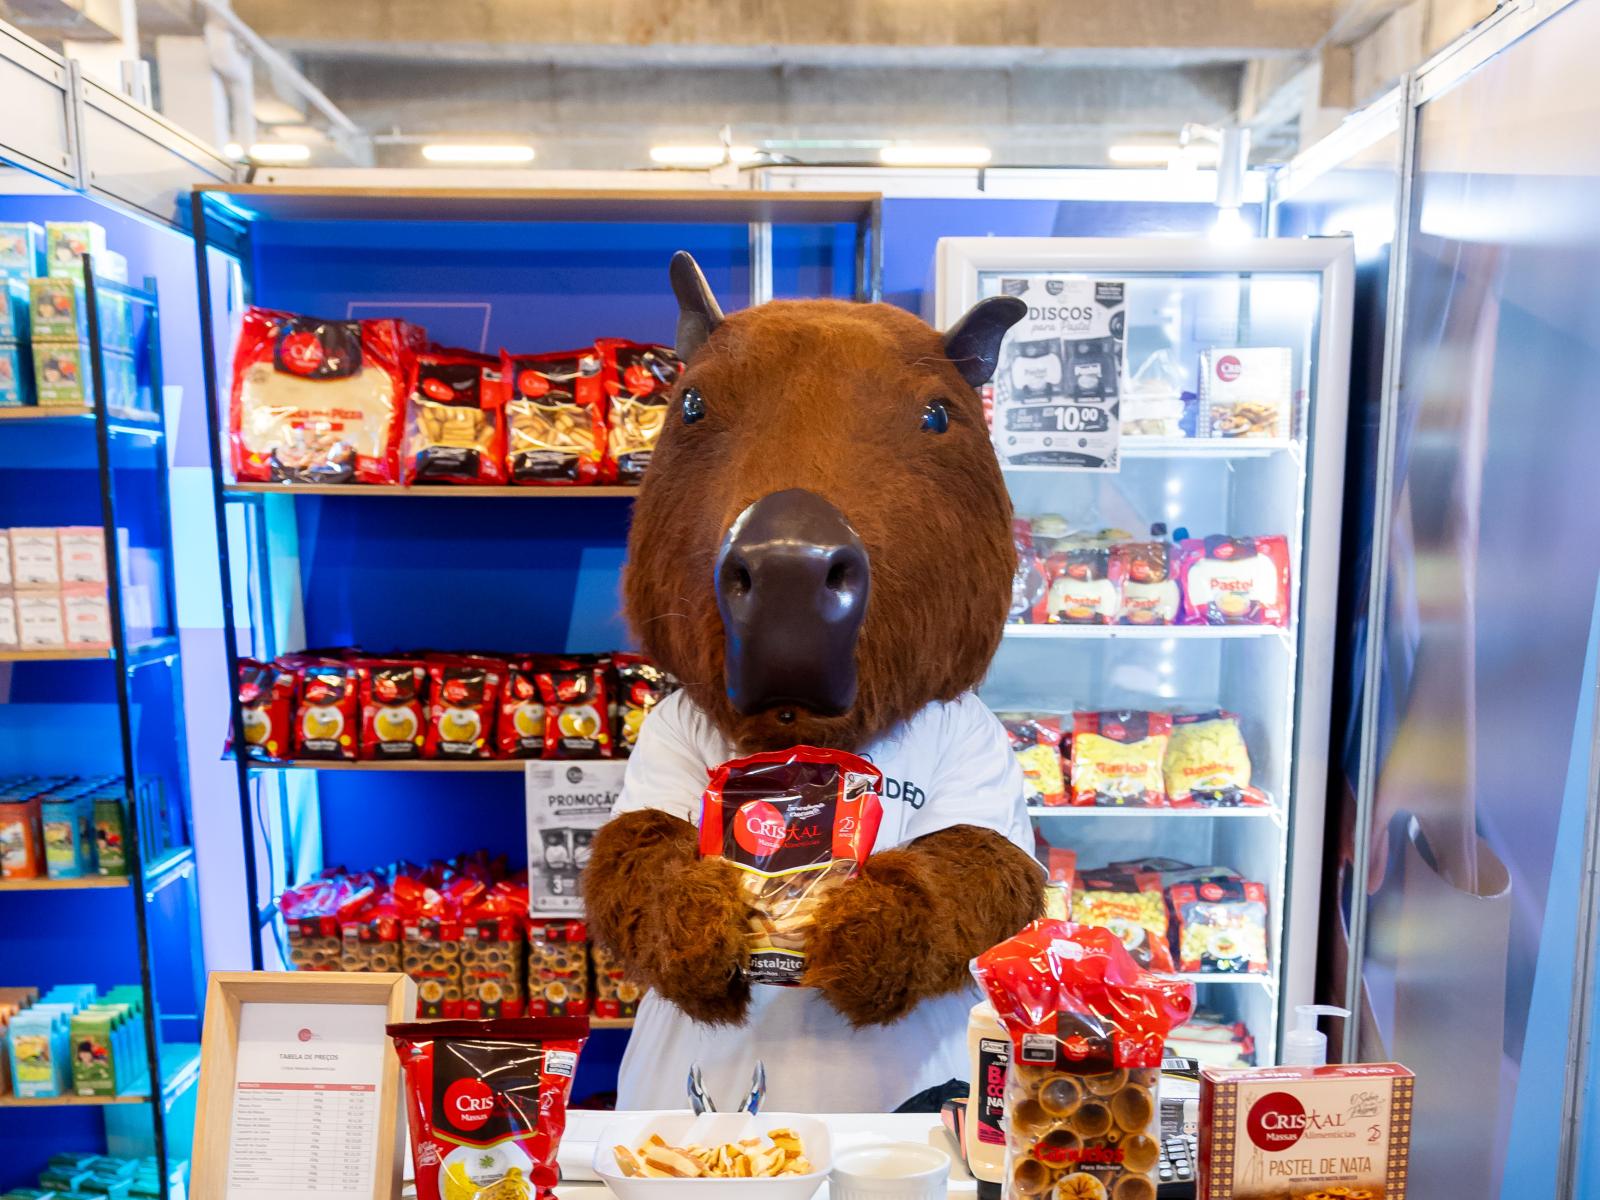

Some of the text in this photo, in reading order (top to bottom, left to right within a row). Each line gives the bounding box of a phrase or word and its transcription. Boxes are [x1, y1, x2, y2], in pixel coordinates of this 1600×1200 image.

[1028, 306, 1093, 321] DISCOS
[1210, 577, 1254, 593] Pastel
[878, 777, 925, 810] DED
[746, 816, 822, 842] CRISTAL
[751, 957, 804, 971] ristalzito
[1261, 1109, 1345, 1130] CRISTAL
[1266, 1132, 1298, 1141] Massas
[1034, 1142, 1124, 1162] Canudos
[1269, 1156, 1372, 1177] PASTEL DE NATA
